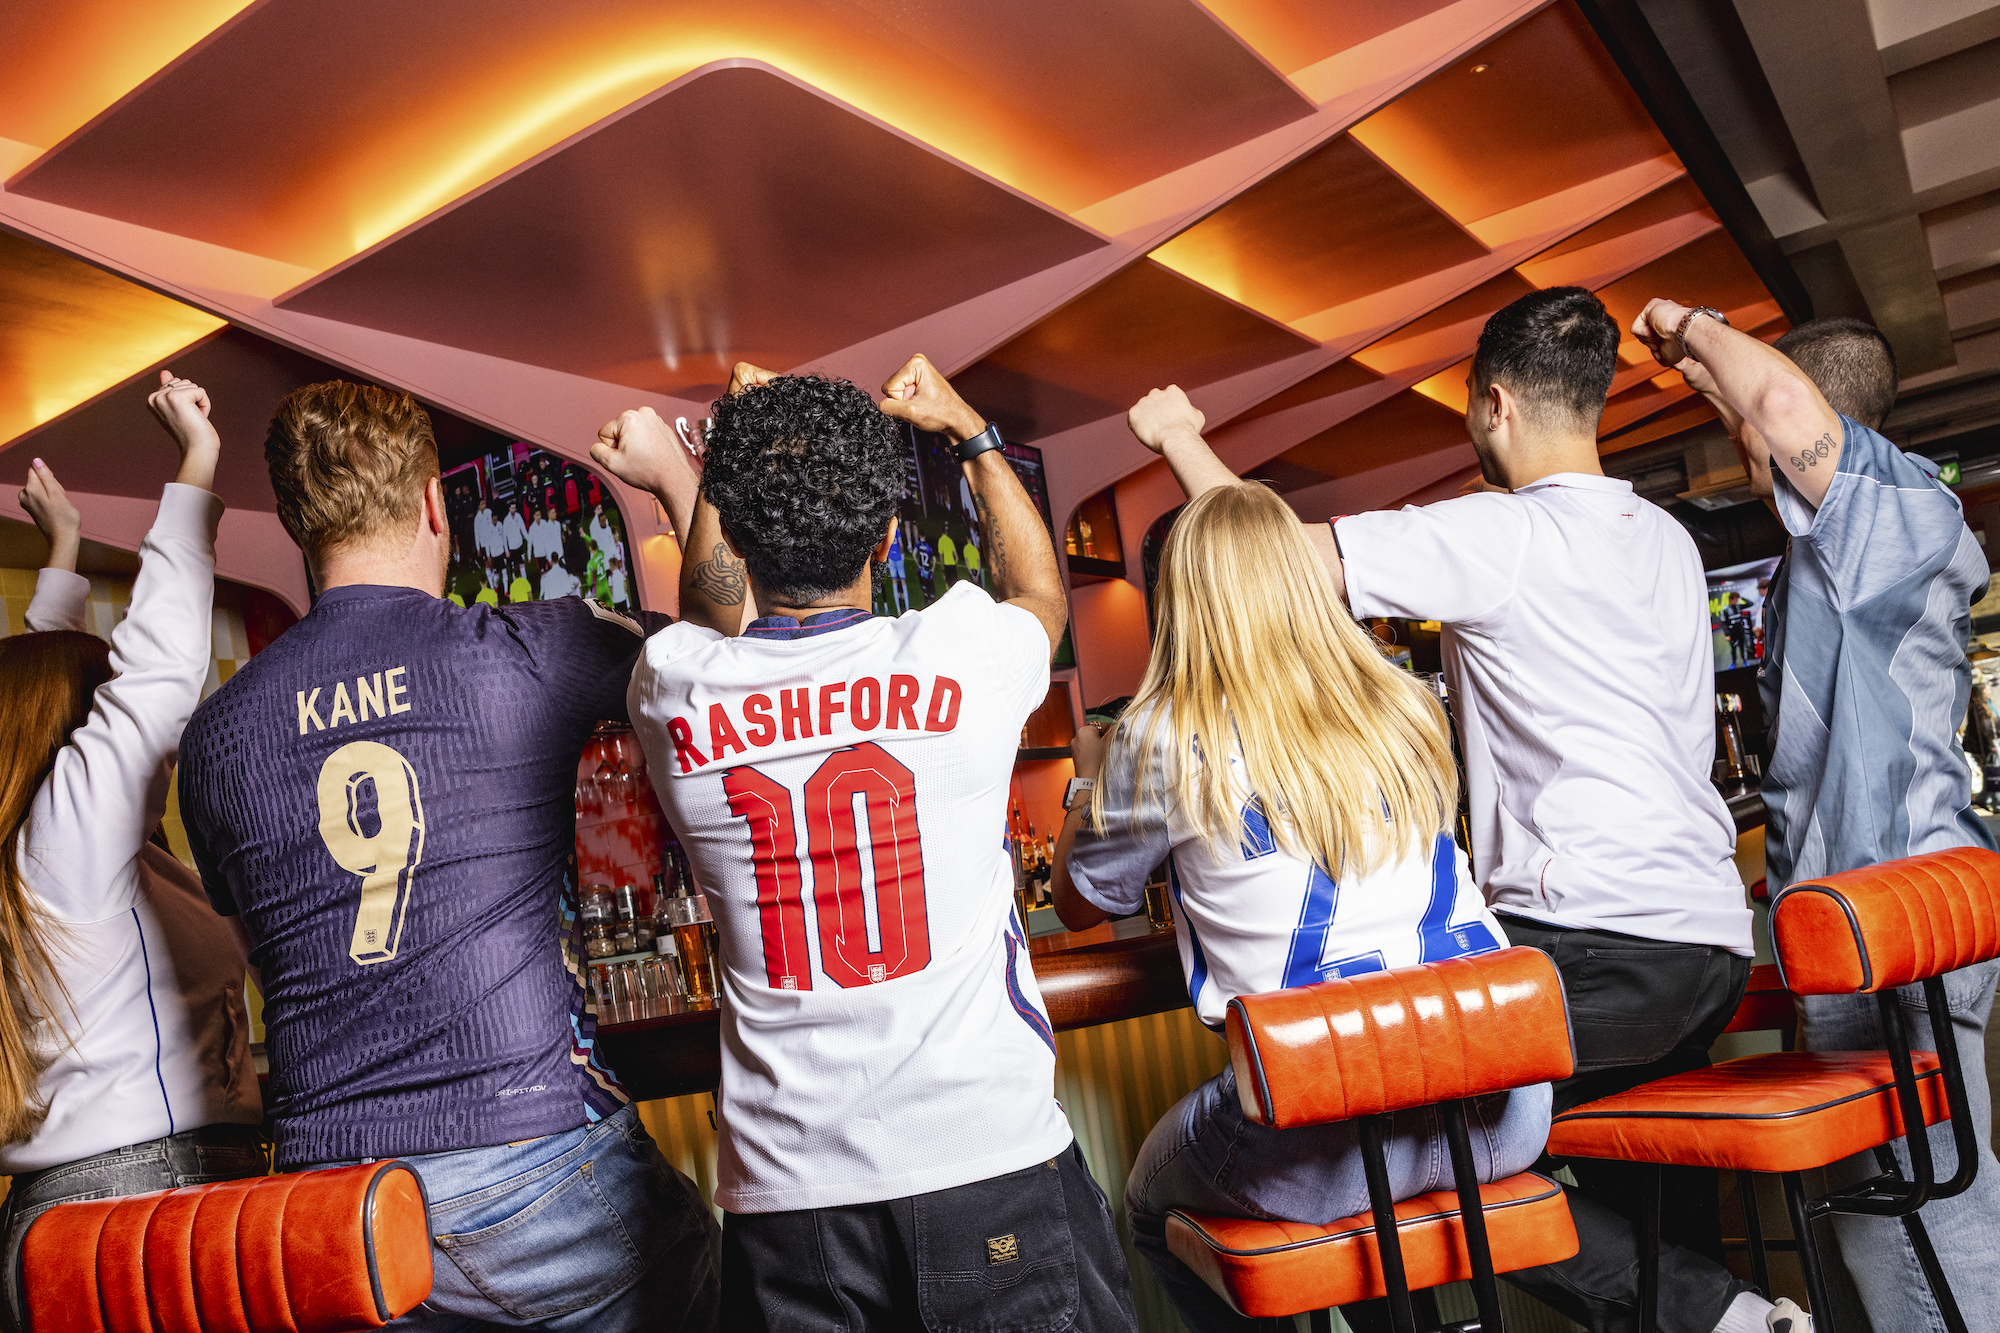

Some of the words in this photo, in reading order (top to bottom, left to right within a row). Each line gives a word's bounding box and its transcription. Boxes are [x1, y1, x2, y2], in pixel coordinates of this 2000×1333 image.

[296, 665, 412, 736] KANE
[666, 674, 963, 774] RASHFORD
[317, 740, 426, 966] 9
[721, 740, 932, 992] 10
